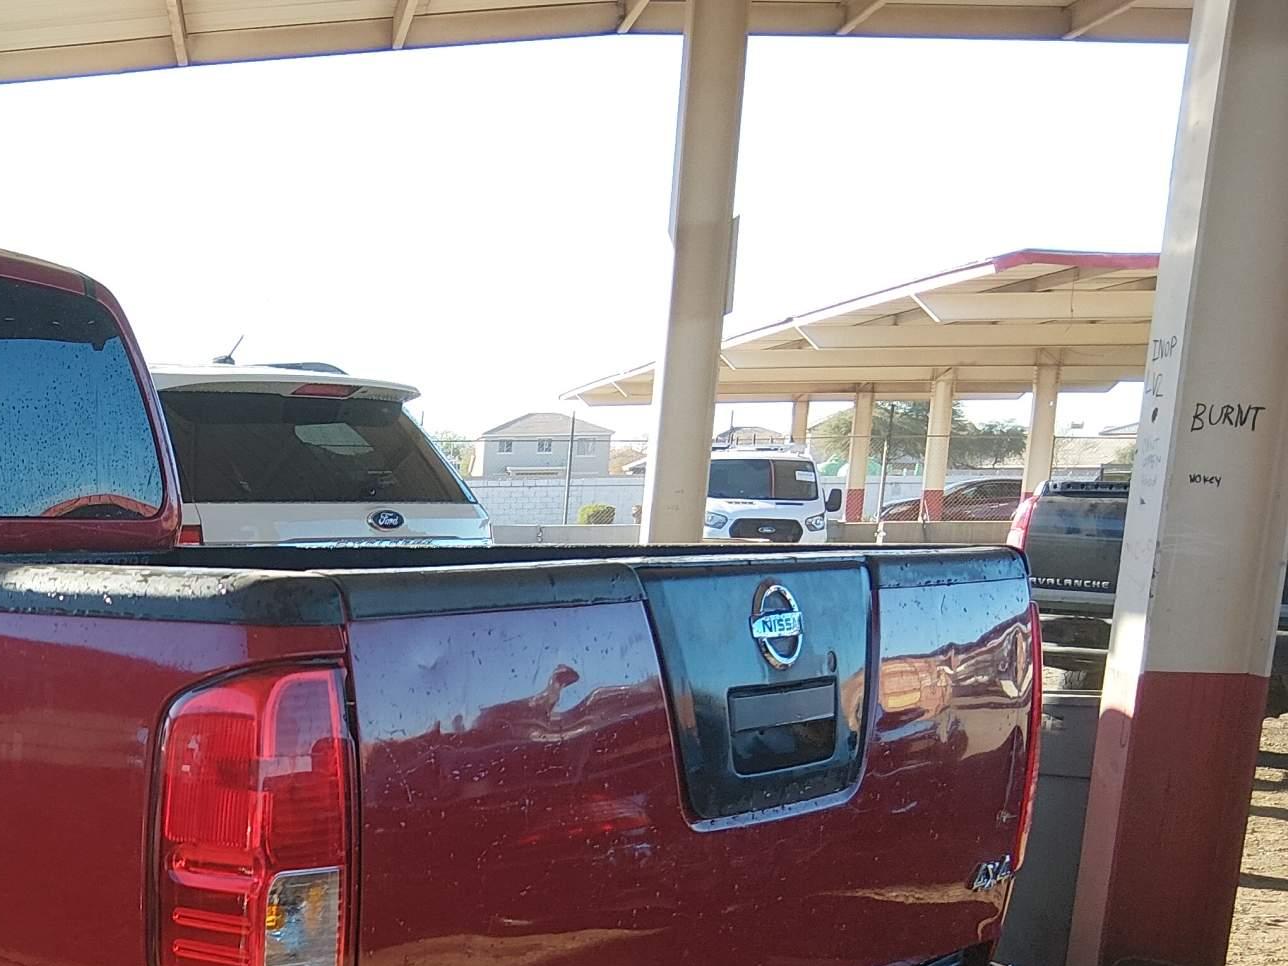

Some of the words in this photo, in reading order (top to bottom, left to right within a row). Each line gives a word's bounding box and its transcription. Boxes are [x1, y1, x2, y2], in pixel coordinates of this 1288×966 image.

[1152, 335, 1178, 361] INOP
[1190, 402, 1267, 433] BURNT
[1188, 472, 1202, 484] NO
[378, 512, 399, 526] Ford
[1028, 576, 1111, 589] AVALANCHE
[762, 617, 800, 632] NISSA
